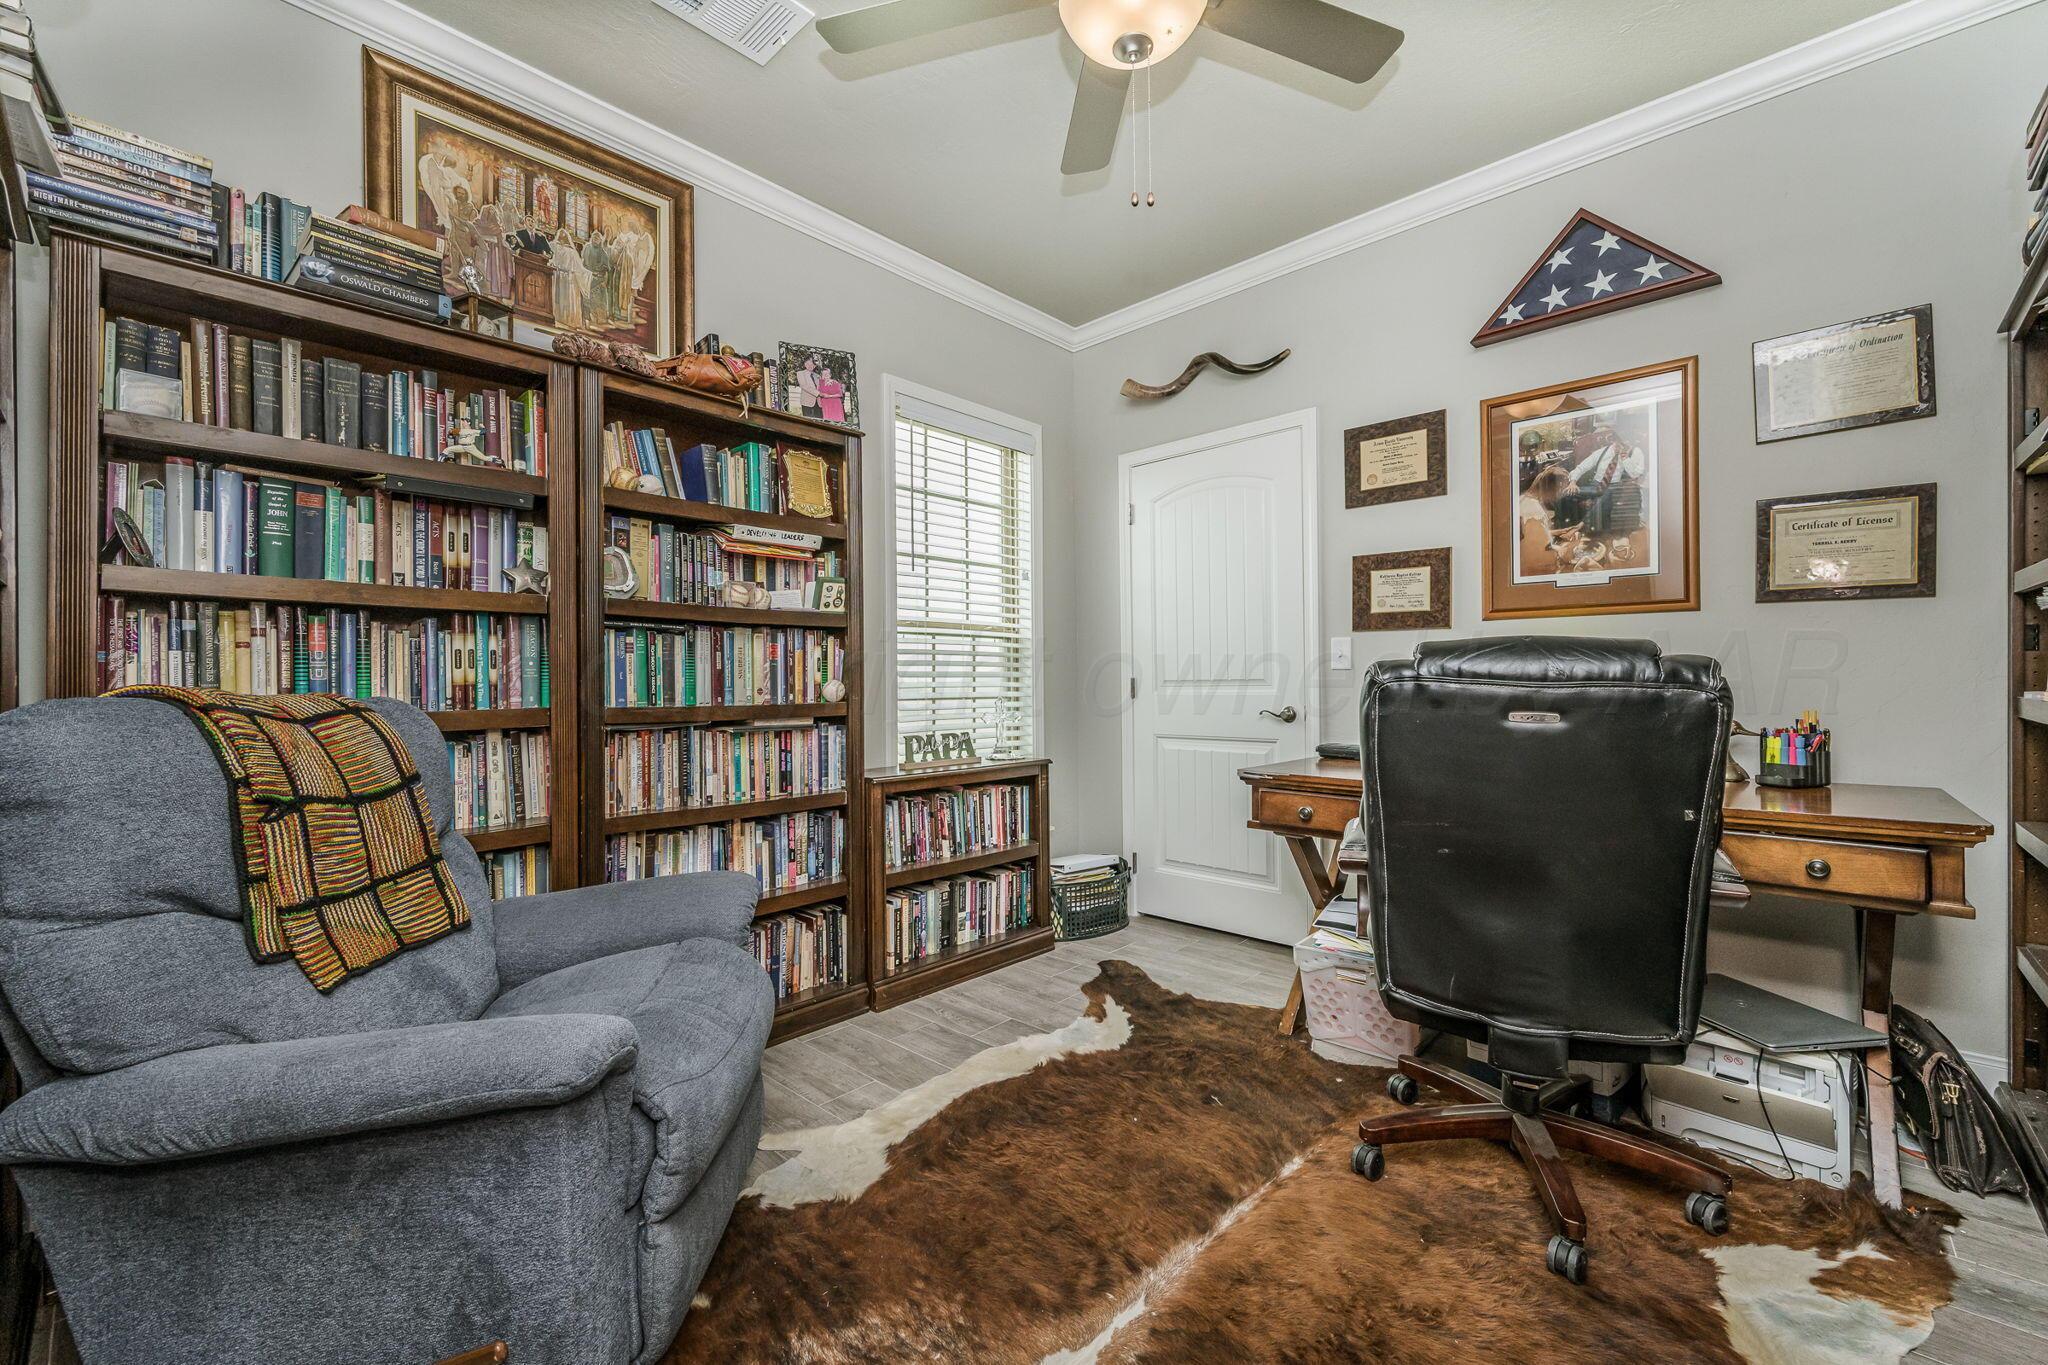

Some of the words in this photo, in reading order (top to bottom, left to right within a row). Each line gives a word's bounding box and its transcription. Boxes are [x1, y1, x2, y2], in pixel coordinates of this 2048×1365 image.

[74, 144, 118, 167] JUDAS
[124, 160, 157, 180] GOAT
[130, 143, 163, 162] VISIONS
[34, 174, 81, 195] BREAKING
[32, 187, 79, 210] NIGHTMARE
[38, 203, 72, 221] PURGING
[340, 273, 381, 293] OSWALD
[382, 284, 429, 307] CHAMBERS
[1860, 333, 1904, 348] Ordination
[769, 366, 777, 384] DAVID
[200, 379, 212, 415] Jeremiah
[266, 508, 289, 517] JOHN
[330, 497, 340, 524] JOHN
[1791, 519, 1839, 531] Certificate
[1841, 517, 1853, 527] of
[1856, 517, 1894, 526] License
[781, 533, 805, 542] LEADERS
[416, 564, 425, 578] WORLD
[205, 618, 214, 657] THESSALONIAN
[206, 657, 214, 682] EPISTLES
[281, 651, 291, 689] THESSALONIANS
[903, 731, 977, 764] PAPA
